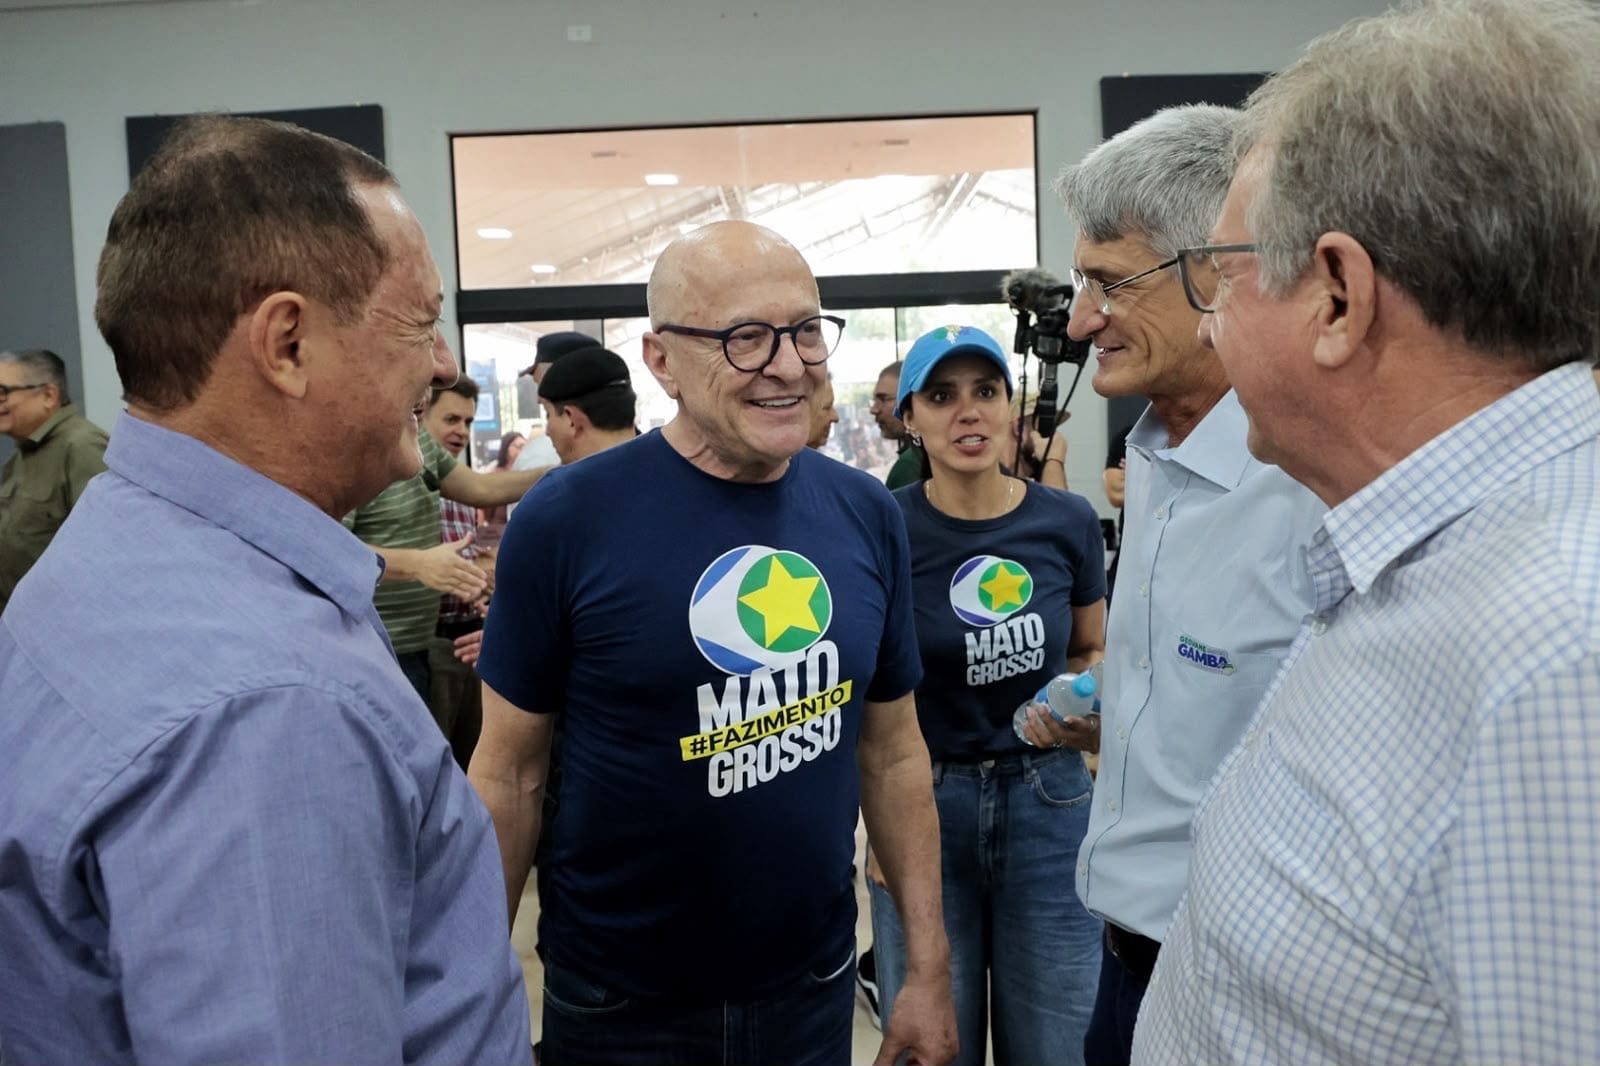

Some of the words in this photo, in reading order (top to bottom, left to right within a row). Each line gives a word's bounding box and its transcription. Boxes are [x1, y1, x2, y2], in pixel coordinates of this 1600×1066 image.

[965, 612, 1045, 664] MATO
[966, 647, 1045, 687] GROSSO
[1178, 643, 1228, 669] GAMBA
[697, 639, 840, 736] MATO
[689, 686, 846, 756] #FAZIMENTO
[708, 706, 842, 798] GROSSO
